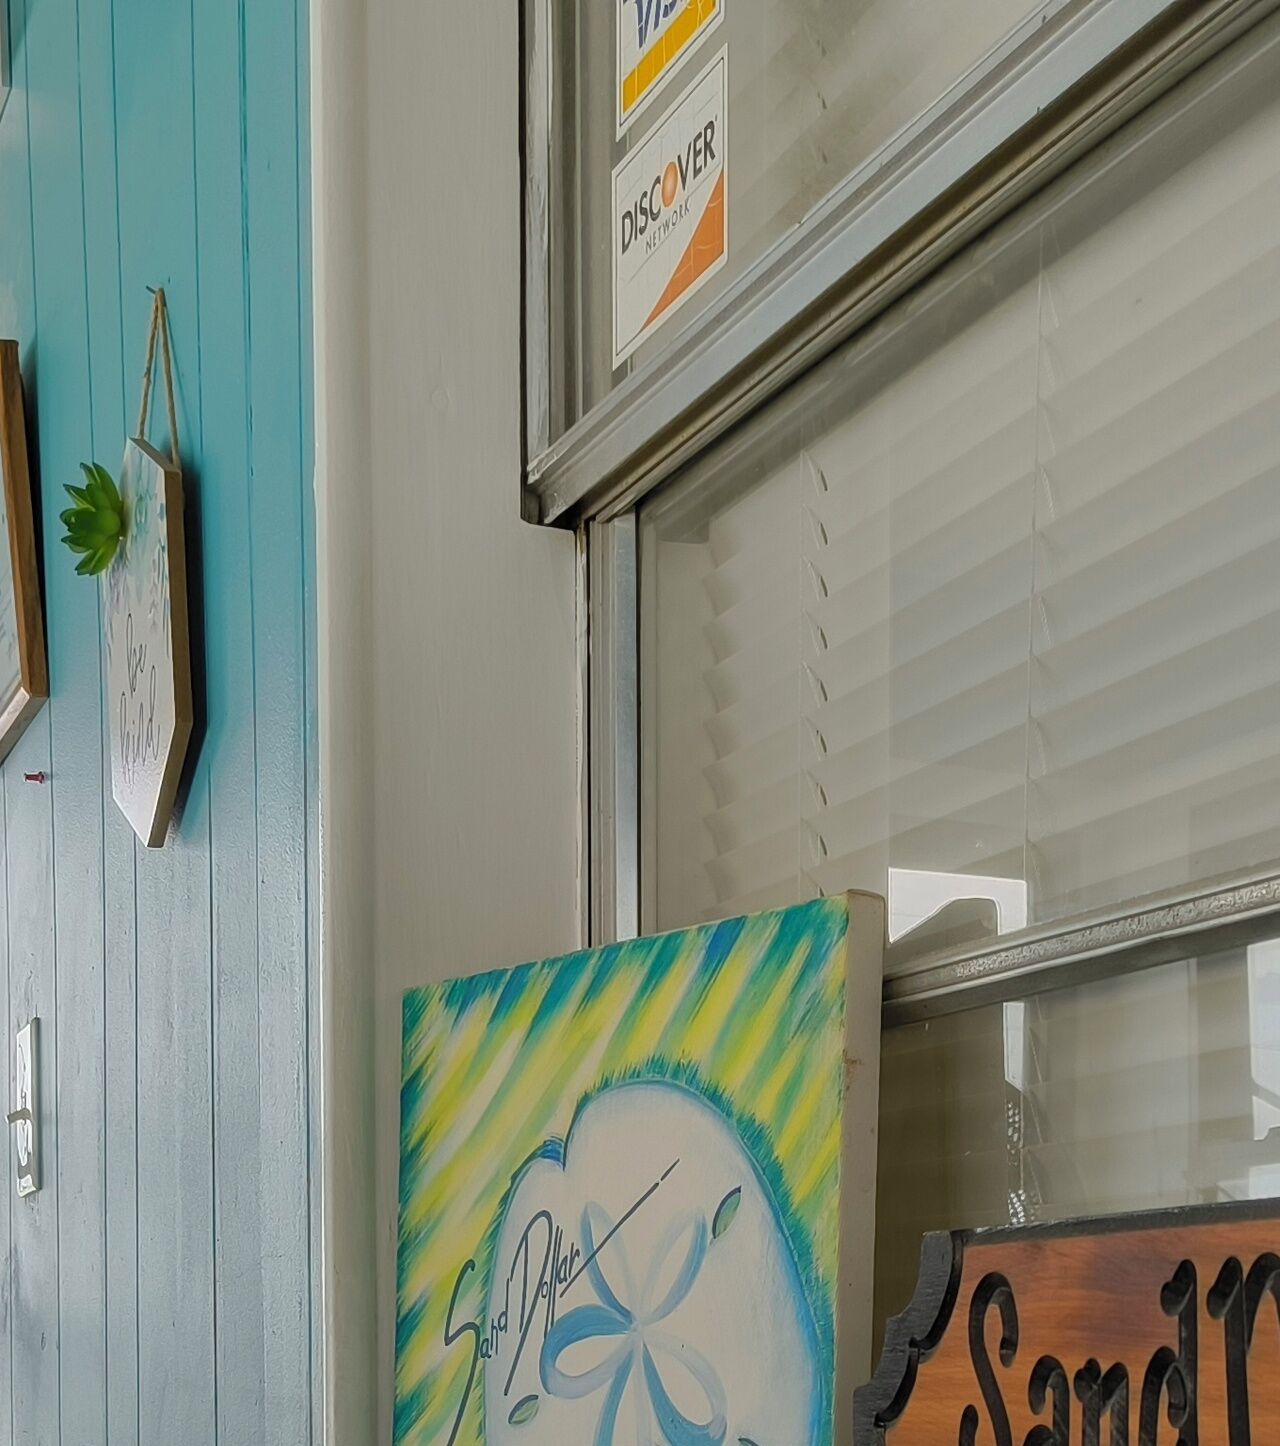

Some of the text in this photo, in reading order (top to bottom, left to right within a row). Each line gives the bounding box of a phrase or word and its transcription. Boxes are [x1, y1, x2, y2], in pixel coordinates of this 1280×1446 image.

[621, 119, 718, 256] DISCOVER
[645, 199, 691, 254] NETWORK
[126, 612, 147, 698] be
[120, 664, 161, 786] kind
[504, 1158, 680, 1397] Dollar
